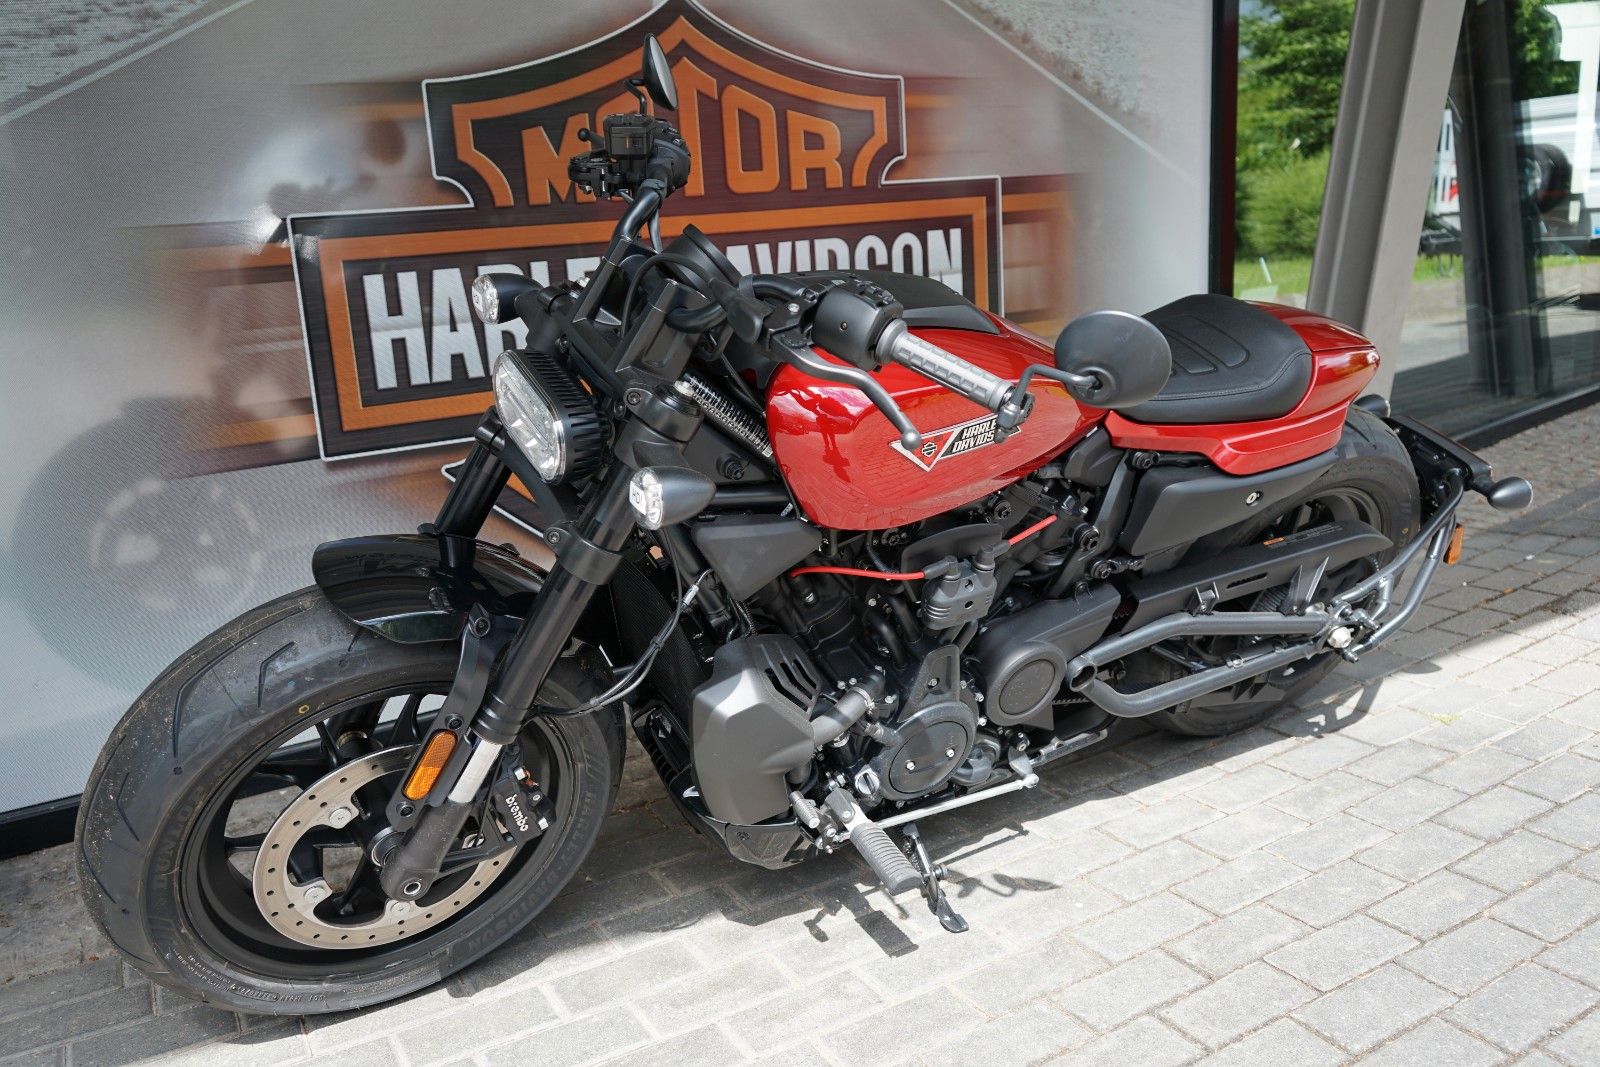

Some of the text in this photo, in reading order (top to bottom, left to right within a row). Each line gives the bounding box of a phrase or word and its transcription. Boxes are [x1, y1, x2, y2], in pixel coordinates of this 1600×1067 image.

[961, 419, 997, 440] HARLE
[952, 430, 996, 453] DAVIDS
[505, 793, 529, 832] brembo
